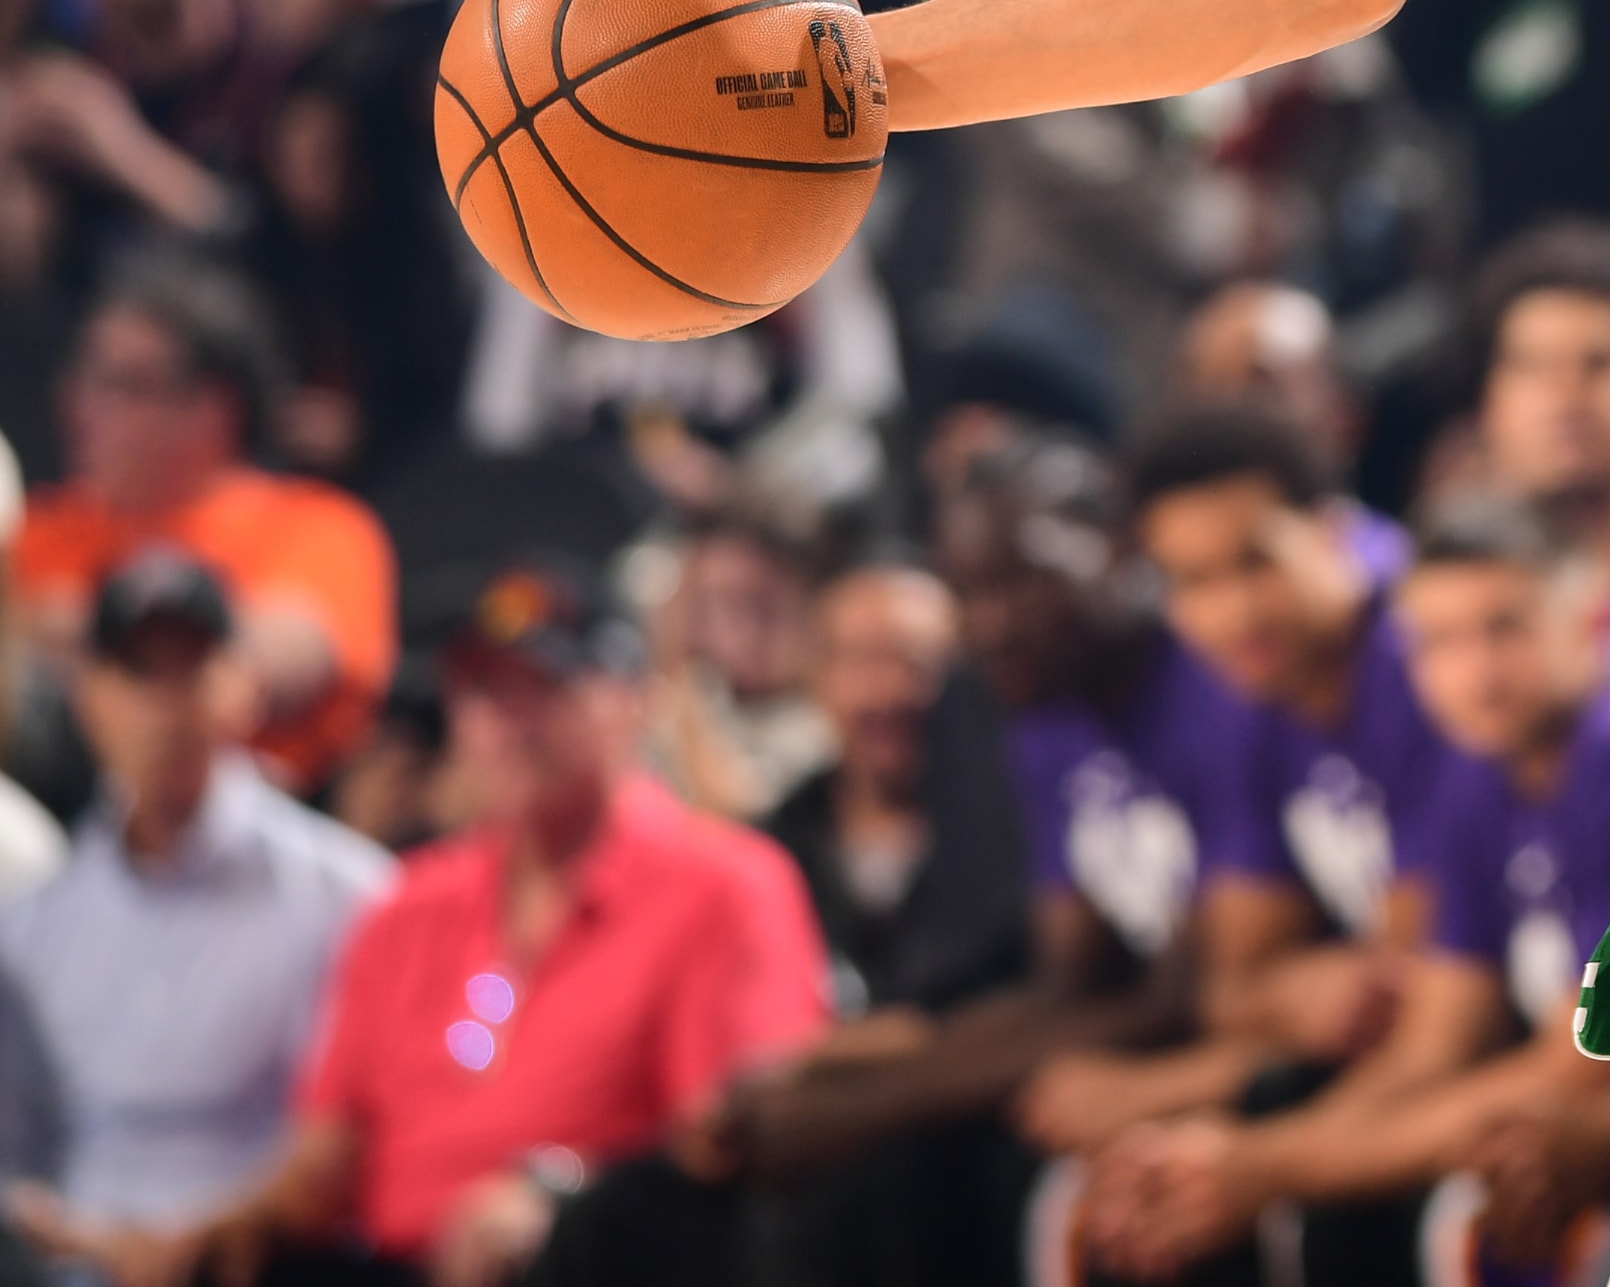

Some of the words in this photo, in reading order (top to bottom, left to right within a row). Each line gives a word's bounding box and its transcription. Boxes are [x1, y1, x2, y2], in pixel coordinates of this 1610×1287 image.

[716, 74, 758, 95] OFFICIAL
[760, 71, 786, 90] GAME
[787, 69, 808, 88] BALL
